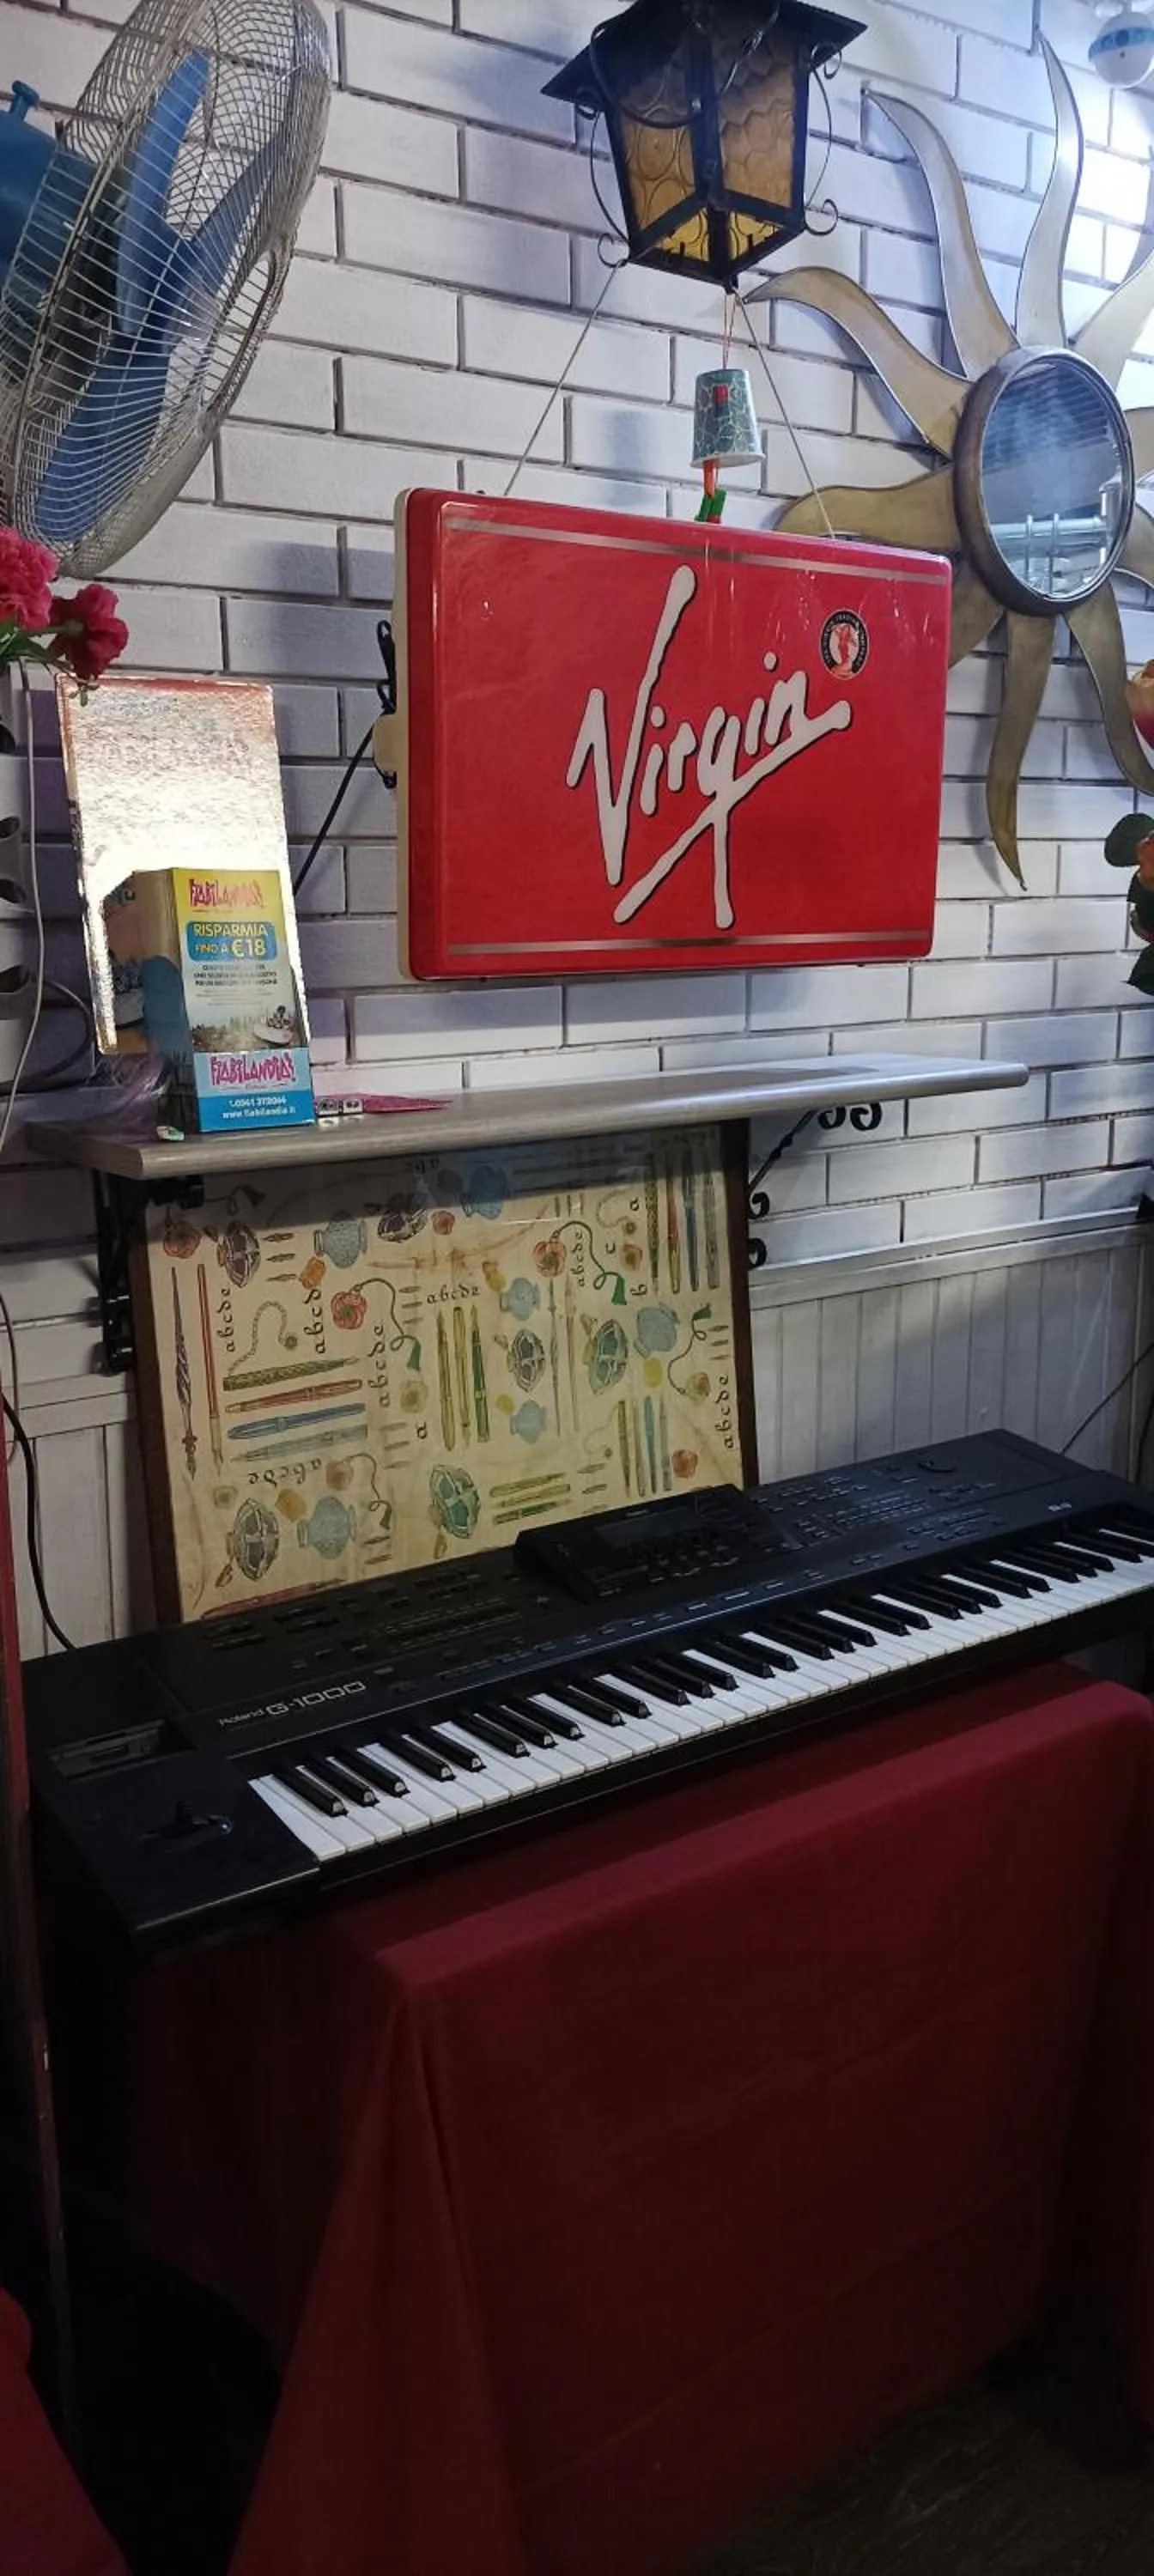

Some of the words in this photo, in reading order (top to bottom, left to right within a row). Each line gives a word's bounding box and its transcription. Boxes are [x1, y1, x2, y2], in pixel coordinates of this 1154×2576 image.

[566, 564, 852, 929] Virgin
[193, 923, 268, 937] RISPARMIA
[195, 944, 218, 954] FINO
[231, 939, 266, 957] €18
[427, 1284, 480, 1304] abcde
[216, 1288, 236, 1352] abcde
[367, 1321, 391, 1408] abcde
[714, 1375, 734, 1449] abcde
[266, 1680, 367, 1716] G-1000
